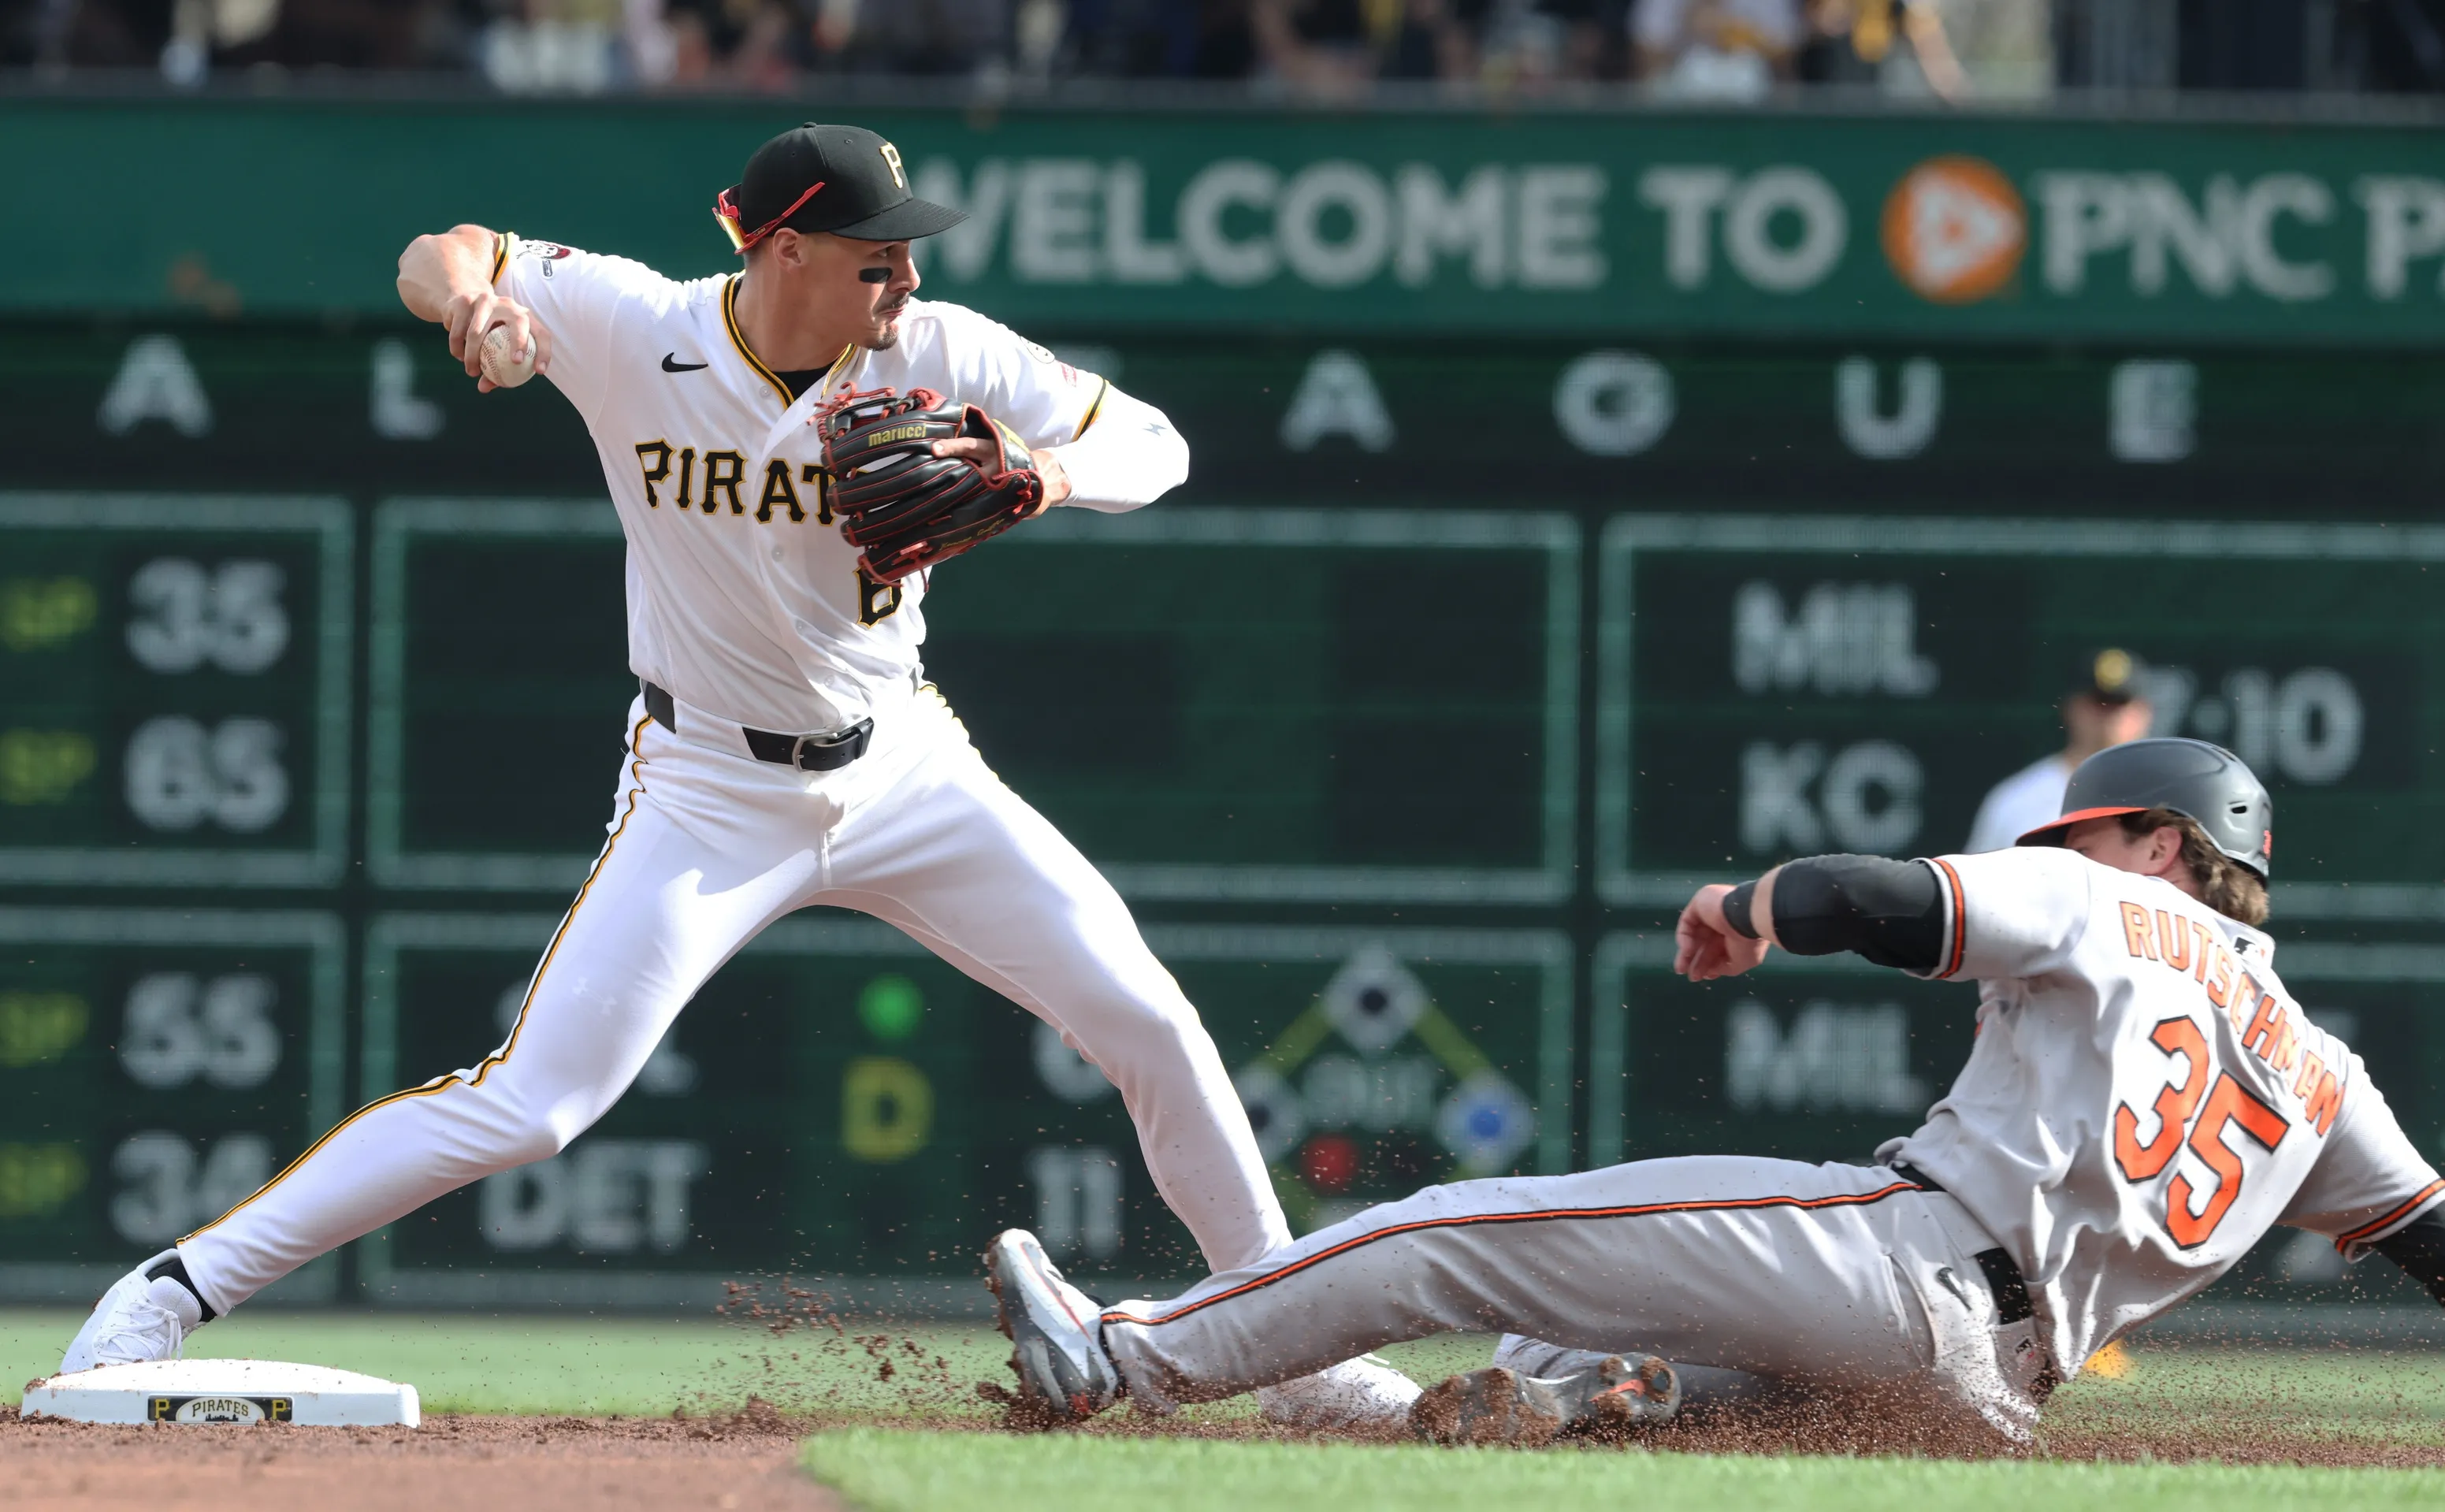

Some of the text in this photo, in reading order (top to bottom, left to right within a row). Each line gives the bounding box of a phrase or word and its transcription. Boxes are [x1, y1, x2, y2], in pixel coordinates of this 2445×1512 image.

[879, 142, 902, 190] P
[911, 158, 2445, 300] WELCOME TO PNC P
[634, 438, 840, 527] PIRAT
[868, 423, 927, 448] marucci
[126, 559, 289, 673] 35
[1741, 741, 1924, 855] KC
[2120, 901, 2346, 1138] RUTSCHMAN
[2113, 1014, 2291, 1251] 35
[481, 1139, 705, 1251] DET
[154, 1399, 288, 1420] P PIRATES P
